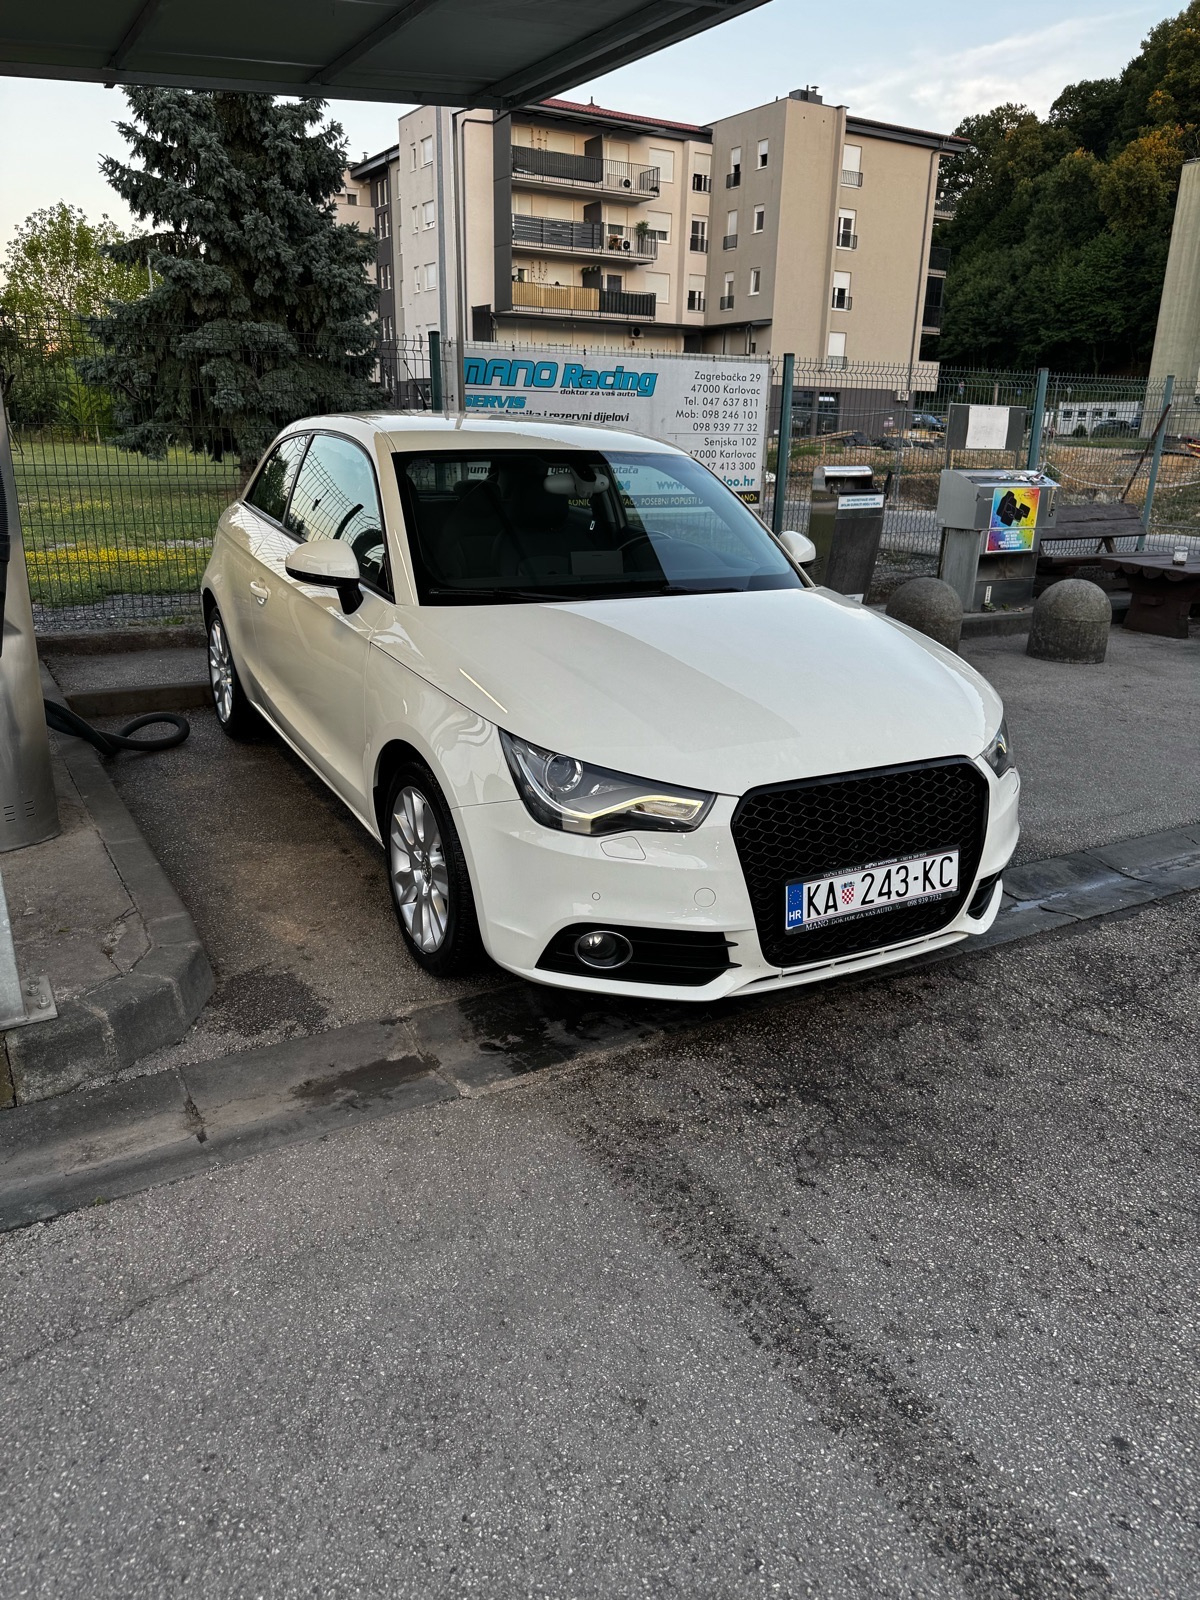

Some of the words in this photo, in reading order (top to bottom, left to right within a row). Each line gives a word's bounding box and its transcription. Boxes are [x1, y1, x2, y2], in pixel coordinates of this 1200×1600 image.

[560, 363, 659, 397] Racing
[694, 371, 747, 383] Zagrebačka
[749, 373, 761, 382] 29
[560, 388, 588, 396] doktor
[690, 384, 720, 394] 47000
[723, 385, 761, 395] Karlovac
[465, 395, 527, 409] SERVIS
[684, 396, 699, 406] Tel.
[702, 397, 720, 406] 047
[722, 398, 740, 407] 637
[742, 398, 759, 407] 811
[593, 412, 630, 423] dijelovi
[675, 409, 699, 418] Mob:
[702, 410, 720, 419] 098
[722, 410, 739, 419] 246
[743, 410, 758, 420] 101
[692, 422, 710, 432] 098
[713, 422, 730, 432] 939
[733, 423, 744, 432] 77
[746, 423, 758, 432] 32
[704, 437, 738, 448] Senjska
[741, 438, 757, 446] 102
[719, 450, 757, 459] Karlovac
[719, 462, 736, 470] 413
[738, 461, 756, 470] 300
[671, 496, 697, 505] POPUSTI
[807, 882, 838, 918] KA
[860, 856, 953, 906] 243-KC
[788, 909, 802, 922] HR
[805, 918, 829, 931] MANO
[876, 905, 893, 916] AUTO
